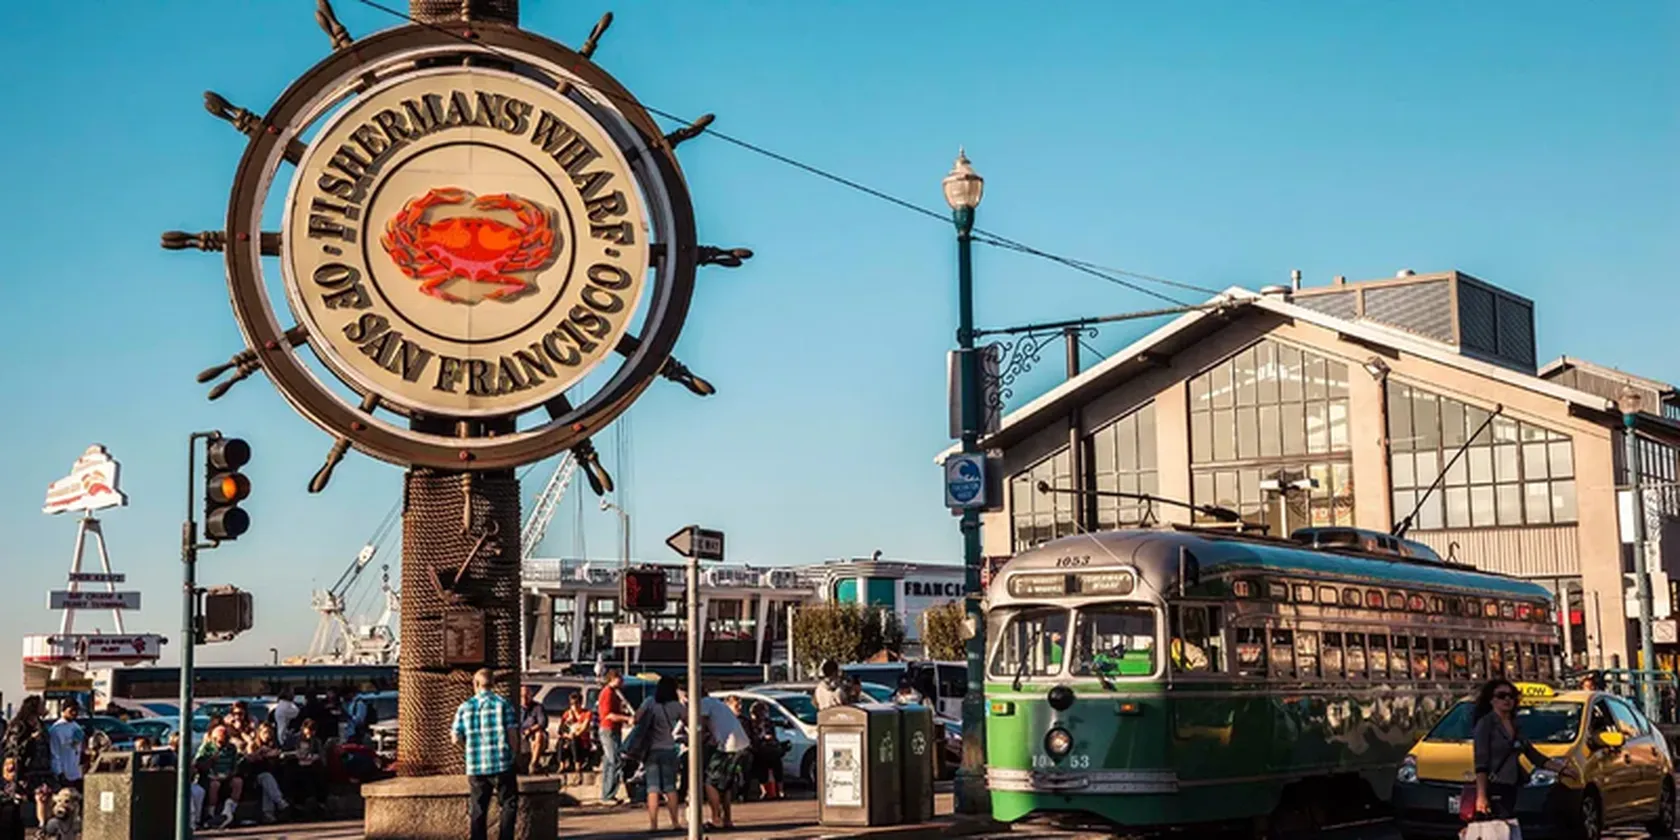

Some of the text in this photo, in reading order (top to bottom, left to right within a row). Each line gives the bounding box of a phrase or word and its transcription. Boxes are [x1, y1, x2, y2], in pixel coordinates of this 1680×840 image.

[308, 90, 635, 246] FISHERMANS WHARF
[313, 263, 633, 397] OF SAN FRANCISCO
[1055, 555, 1091, 567] 1053
